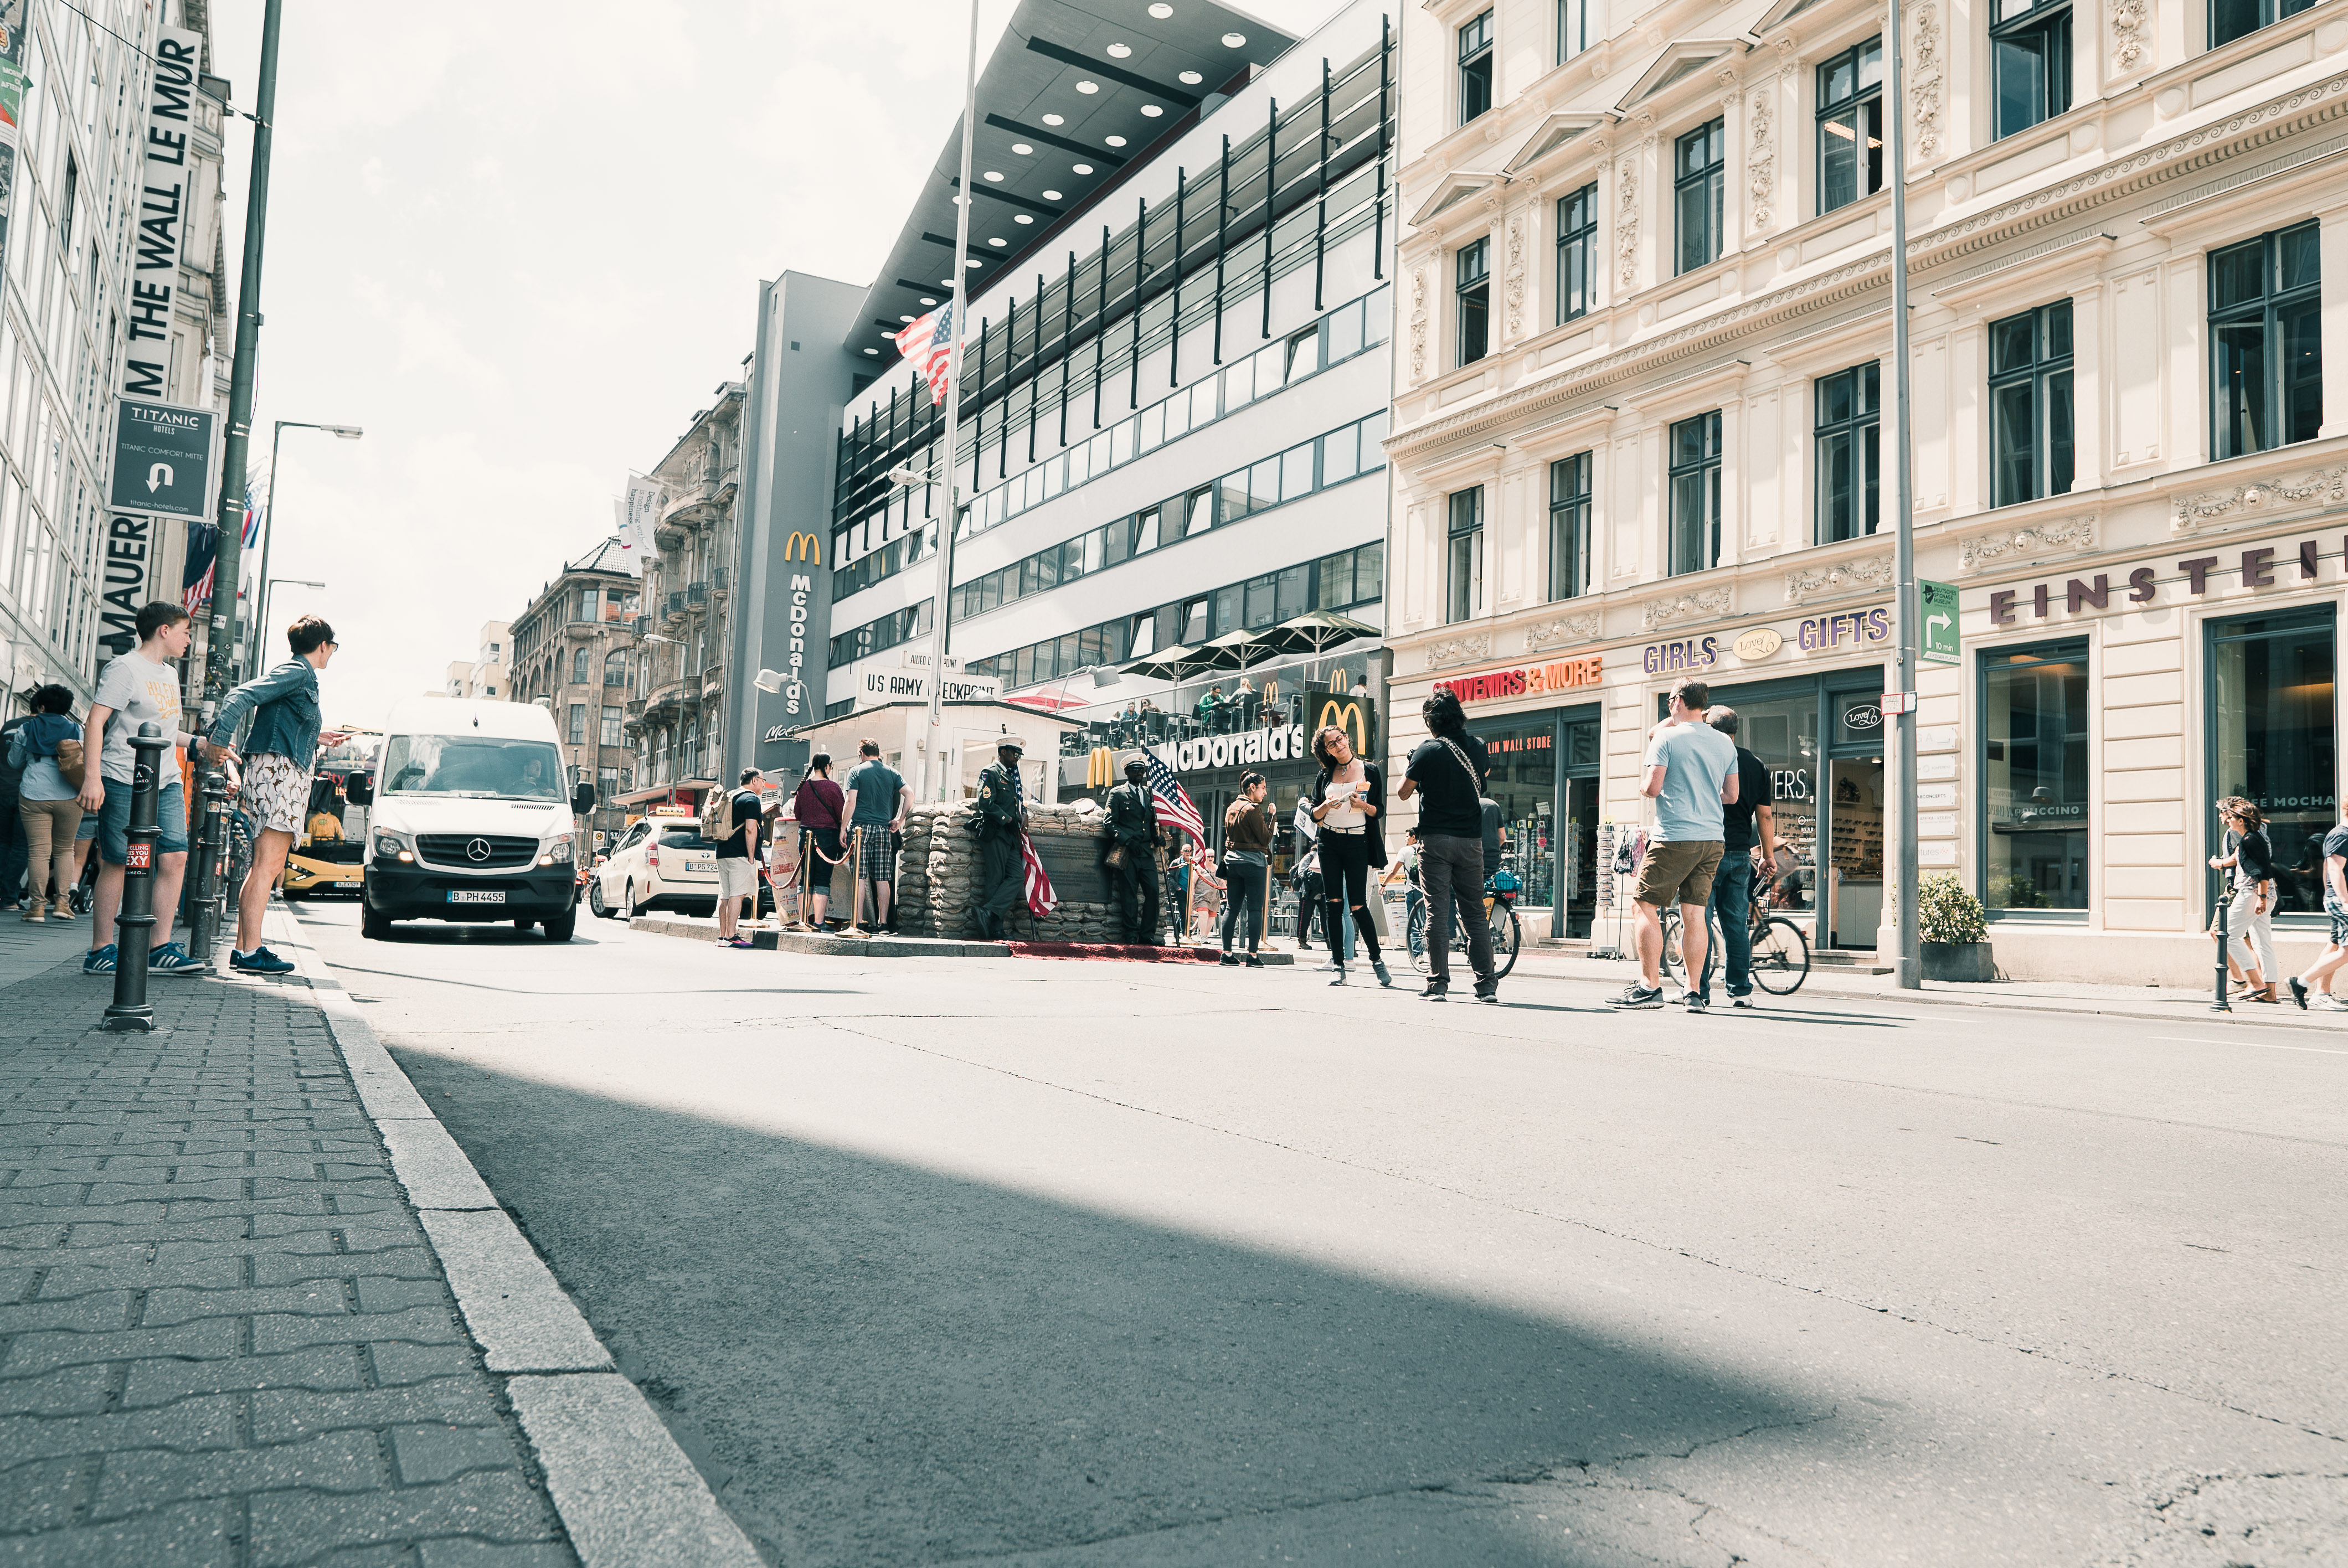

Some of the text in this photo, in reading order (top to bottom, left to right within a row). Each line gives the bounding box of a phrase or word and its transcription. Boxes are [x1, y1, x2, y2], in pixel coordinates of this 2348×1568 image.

[152, 39, 195, 122] MUR
[148, 126, 186, 166] LE
[136, 183, 181, 270] WALL
[129, 280, 171, 341] THE
[132, 407, 199, 427] TITANIC
[153, 425, 175, 435] HOTELS
[121, 443, 146, 452] TITANIC
[148, 447, 183, 457] COMFORT
[130, 499, 189, 512] titanic-hotels.com
[628, 489, 638, 524] happiness
[635, 496, 643, 523] nothing
[644, 491, 655, 513] Design
[1990, 535, 2348, 625] EINSTEI
[1934, 587, 1956, 596] DEUTSCHES
[1934, 592, 1954, 601] SPIONAGE
[1642, 636, 1718, 674] GIRLS
[1797, 607, 1889, 653] GIFTS
[1935, 642, 1954, 652] 10 min
[910, 654, 957, 668] ALLIED CPOINT
[868, 674, 884, 692] US
[890, 677, 923, 696] ARMY
[1527, 667, 1544, 692] &
[1545, 657, 1602, 689] MORE
[1158, 724, 1304, 772] McDonald's
[1503, 737, 1523, 752] WALL
[1527, 735, 1551, 750] STORE
[2274, 796, 2335, 807] MOCHA
[126, 855, 148, 866] EXY
[454, 893, 504, 901] B PH 4455
